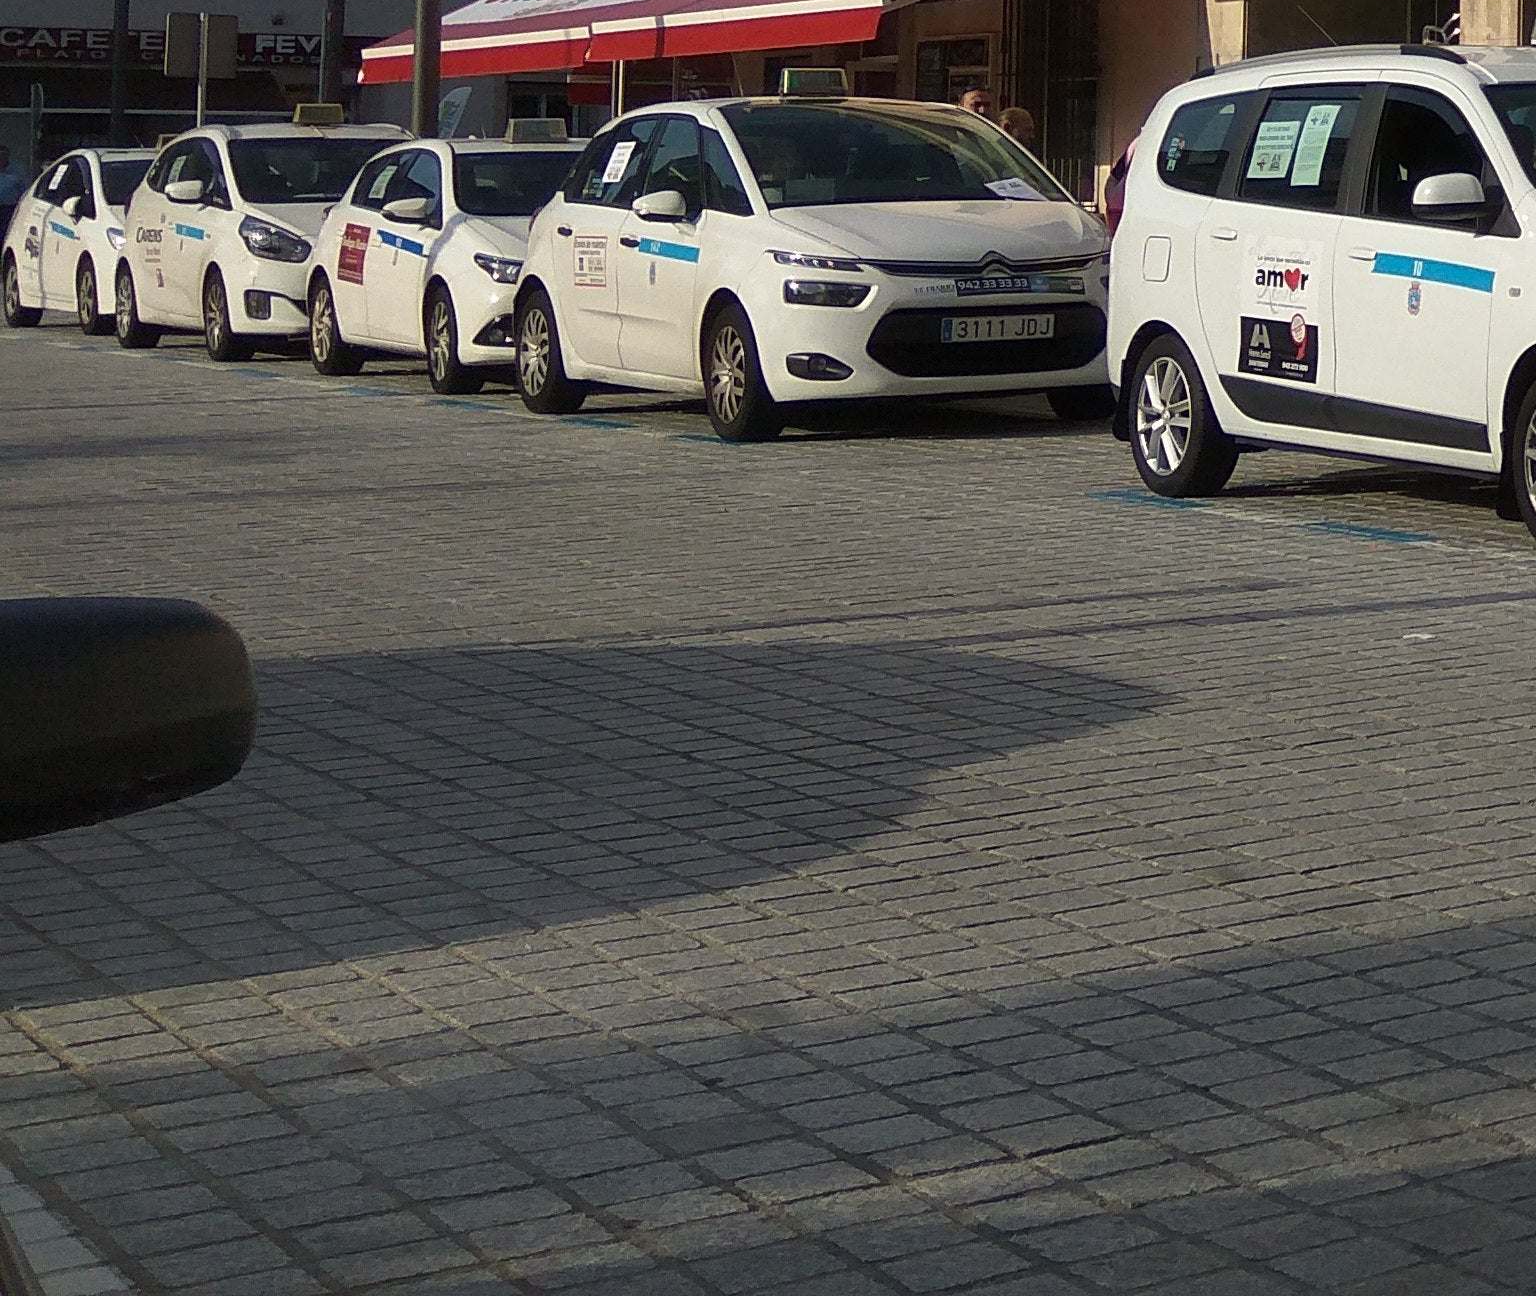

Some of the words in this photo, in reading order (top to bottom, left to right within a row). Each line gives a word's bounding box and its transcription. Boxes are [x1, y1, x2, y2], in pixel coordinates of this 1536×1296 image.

[1413, 260, 1423, 277] 10
[957, 280, 981, 291] 942
[983, 279, 996, 289] 33
[999, 279, 1013, 288] 33
[1014, 277, 1028, 288] 33
[957, 319, 1005, 339] 3111
[1014, 317, 1050, 336] JDJ
